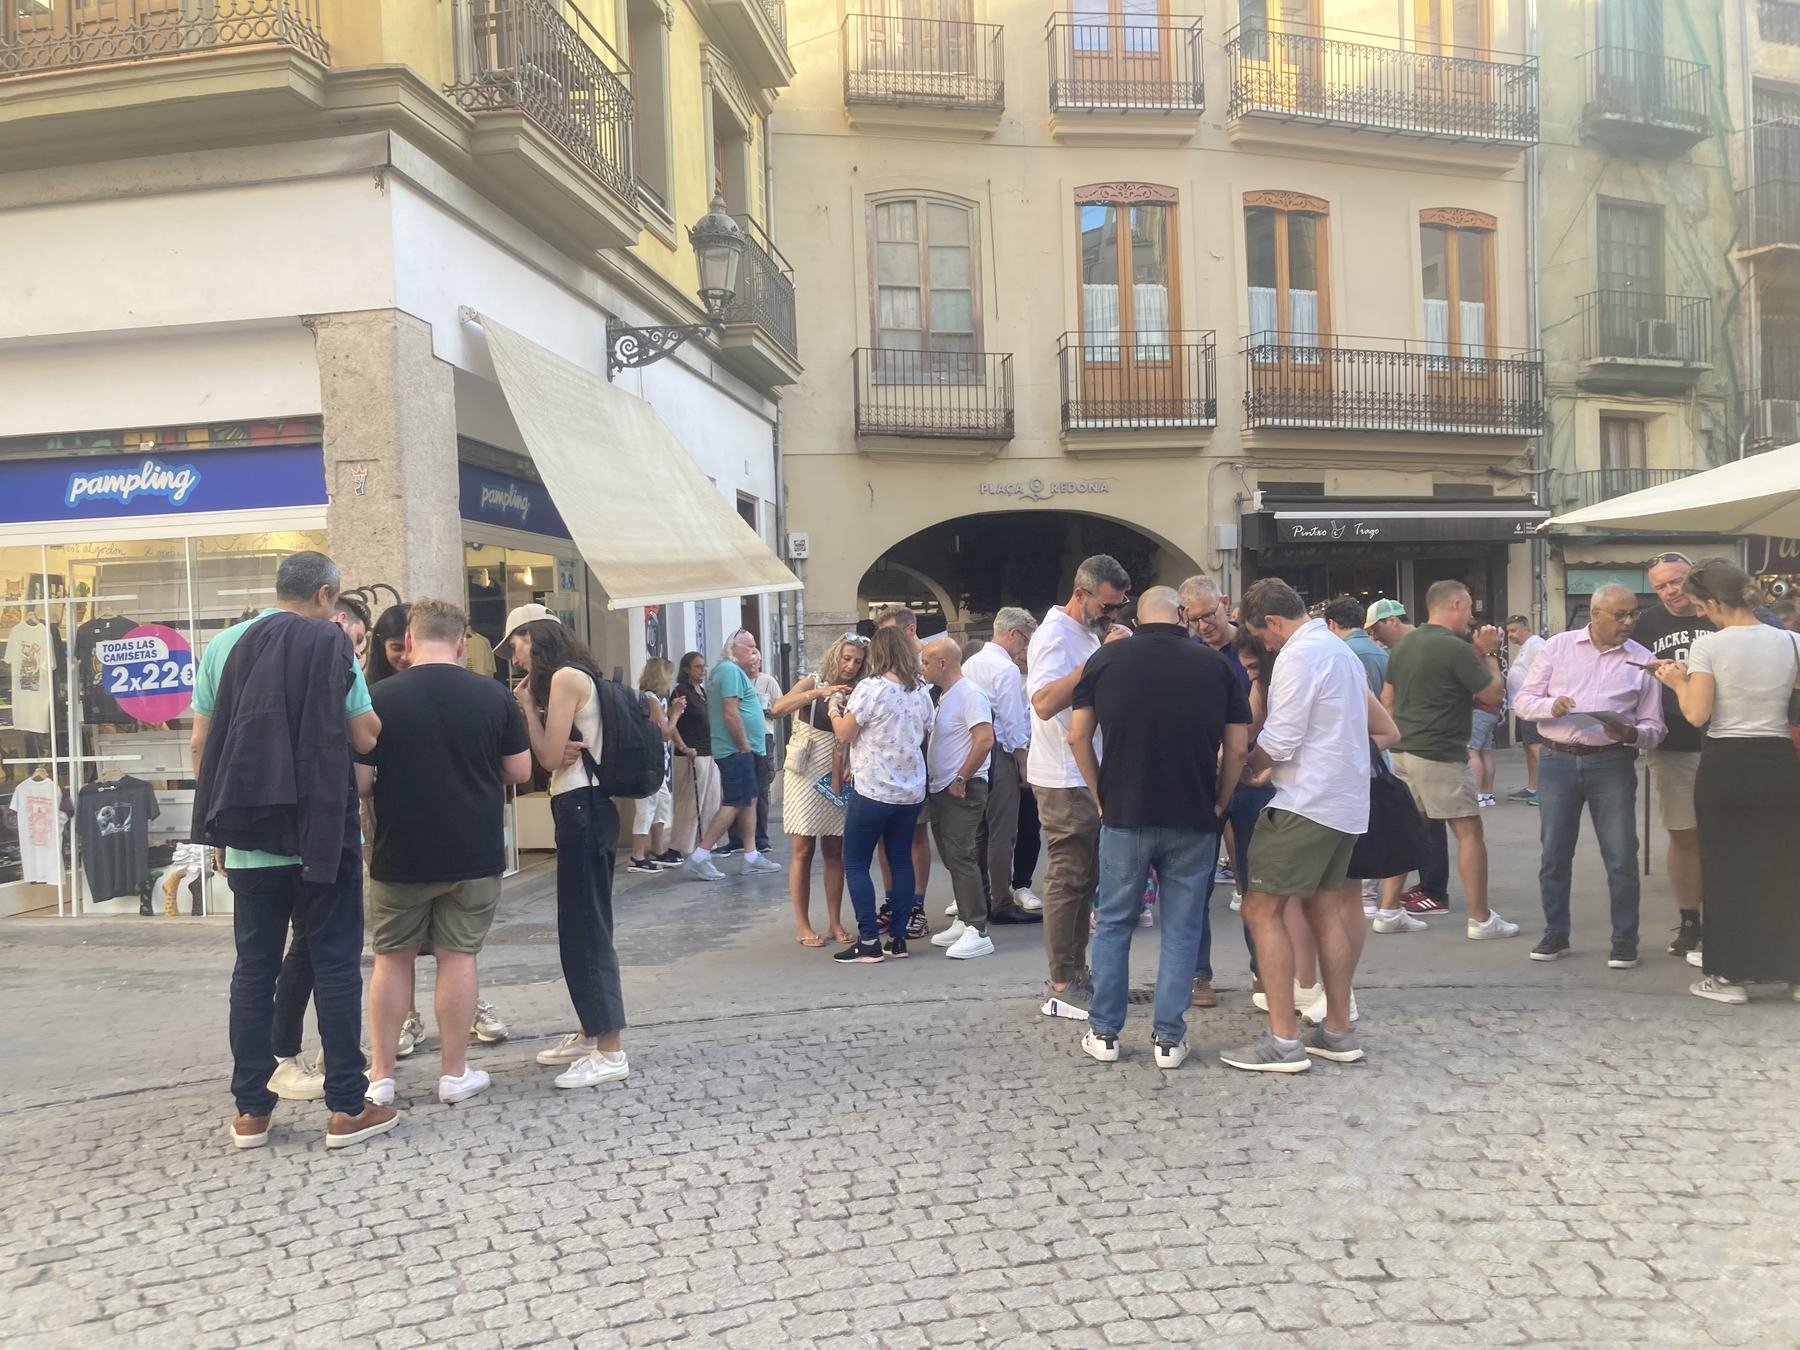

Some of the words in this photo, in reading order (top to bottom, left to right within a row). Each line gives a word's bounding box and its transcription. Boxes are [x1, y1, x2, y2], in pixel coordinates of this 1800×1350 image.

[69, 460, 196, 502] pampling
[980, 482, 1024, 496] PLAÇA
[1050, 481, 1109, 494] REDONA
[481, 483, 531, 520] pampling
[1291, 525, 1327, 537] Pintxo
[1354, 523, 1380, 540] Trago
[102, 642, 134, 653] TODAS
[136, 640, 155, 650] LAS
[103, 650, 158, 663] CAMISETAS
[110, 661, 193, 693] 2x22€
